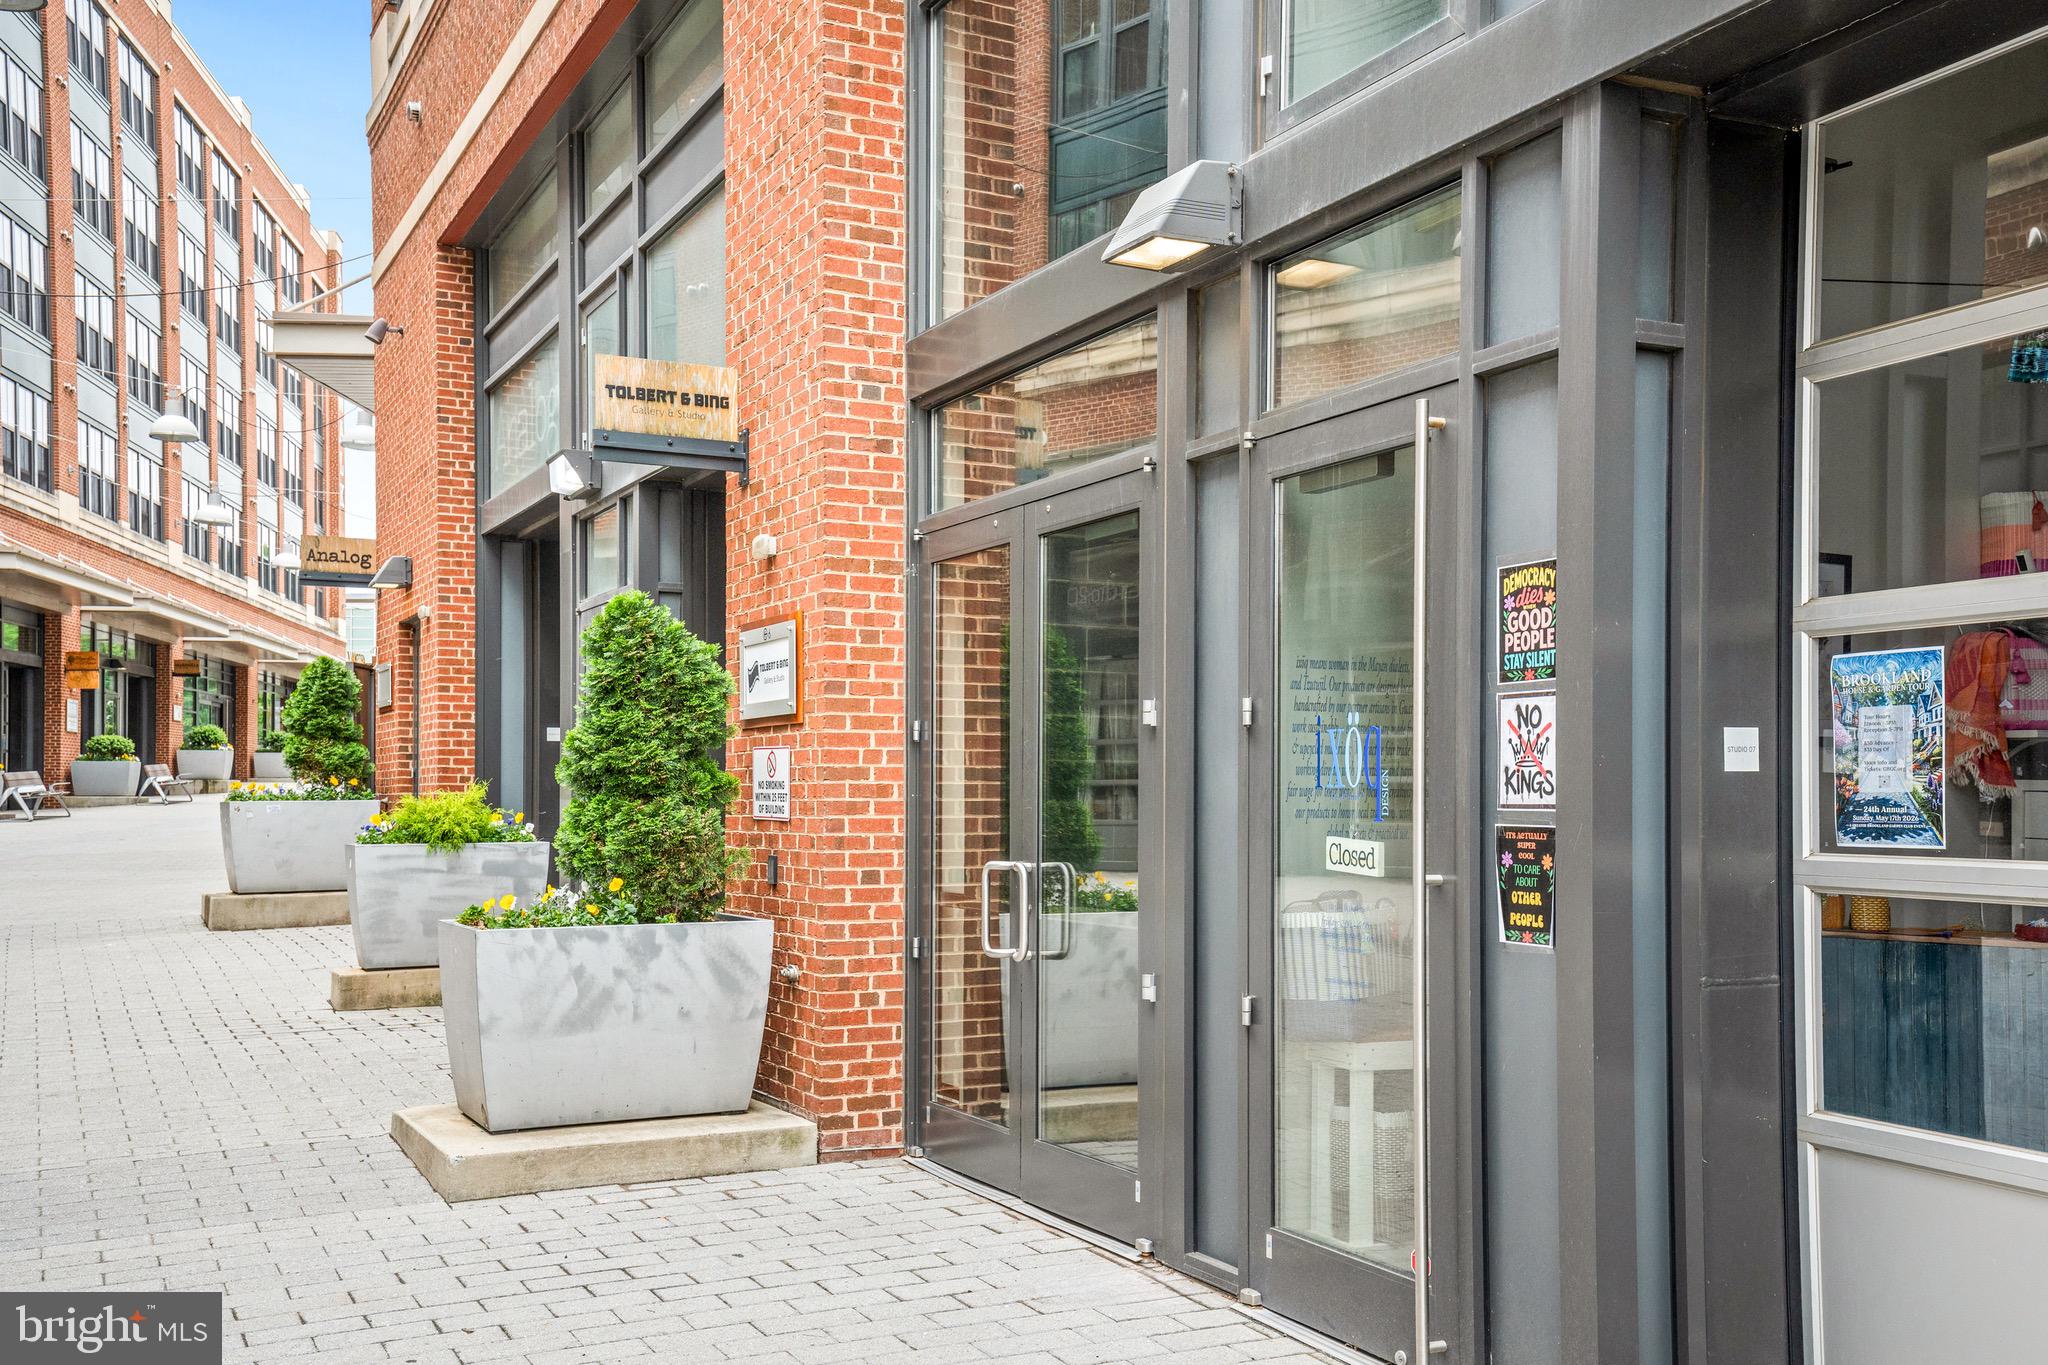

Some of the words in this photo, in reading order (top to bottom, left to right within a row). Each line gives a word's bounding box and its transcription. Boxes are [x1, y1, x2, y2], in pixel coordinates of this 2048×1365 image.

[605, 384, 677, 404] TOLBERT
[681, 392, 691, 405] &
[694, 393, 730, 409] BING
[631, 405, 666, 418] Gallery
[668, 407, 674, 418] &
[677, 408, 706, 421] Studio
[306, 548, 372, 569] Analog
[1503, 567, 1556, 597] DEMOCRACY
[1516, 587, 1543, 607] dies
[1507, 607, 1553, 633] GOOD
[1504, 627, 1556, 653] PEOPLE
[1504, 652, 1525, 670] STAY
[1526, 649, 1556, 667] SILENT
[1842, 669, 1931, 688] BROOKLAND
[1842, 686, 1866, 694] HOUSE
[1875, 684, 1906, 693] GARDEN
[1908, 682, 1930, 691] TOUR
[1515, 704, 1542, 730] NO
[758, 780, 765, 790] NO
[766, 780, 785, 790] SMOKING
[755, 792, 771, 802] WITHIN
[772, 792, 777, 802] 25
[778, 792, 788, 802] FEET
[758, 804, 765, 814] OF
[765, 804, 785, 814] BUILDING
[1863, 805, 1880, 813] 24th
[1881, 805, 1907, 813] Annual
[1517, 831, 1548, 840] ACTUALLY
[1329, 843, 1376, 870] Closed
[1513, 864, 1522, 874] TO
[1523, 864, 1541, 875] CARE
[1515, 877, 1538, 887] ABOUT
[1511, 890, 1542, 906] OTHER
[1510, 912, 1544, 928] PEOPLE
